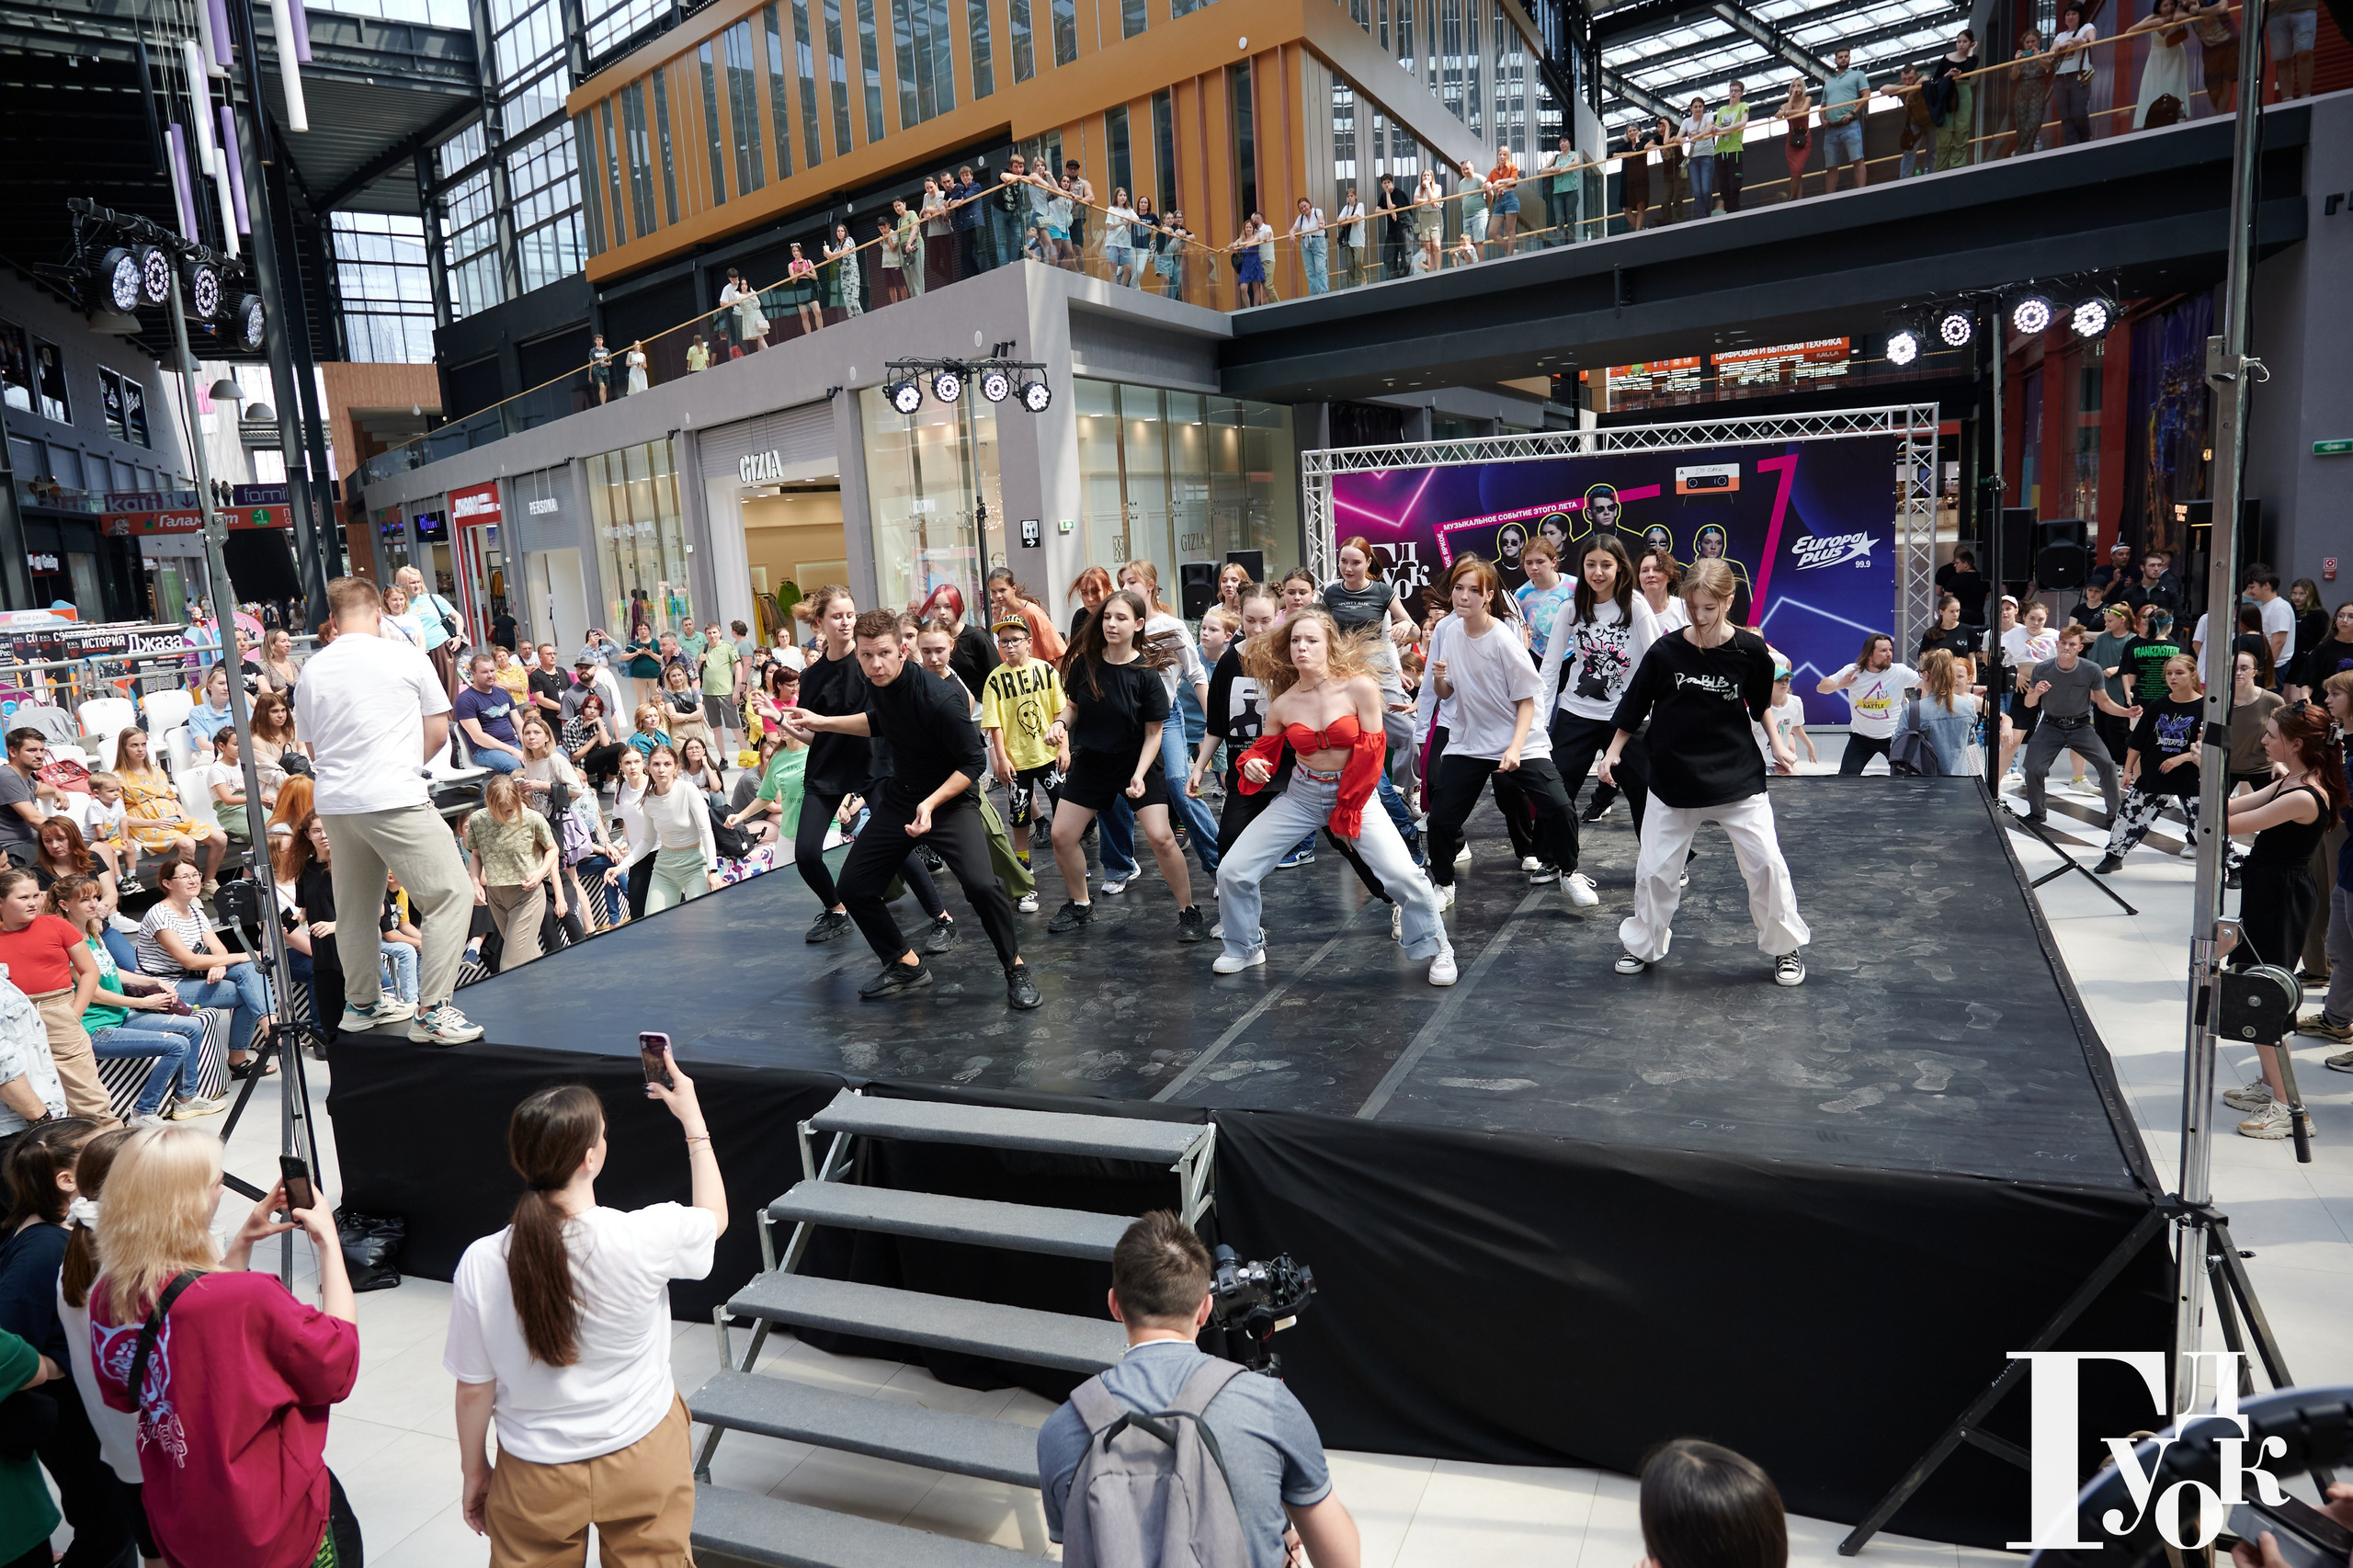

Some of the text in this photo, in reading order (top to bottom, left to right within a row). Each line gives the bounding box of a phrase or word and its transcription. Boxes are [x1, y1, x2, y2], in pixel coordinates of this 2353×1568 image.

[1715, 349, 1758, 361] ЦИФРОВАЯ
[1768, 342, 1804, 354] БЫТОВАЯ
[1805, 337, 1842, 349] ТЕХНИКА
[738, 449, 784, 483] GIZIA
[108, 494, 158, 512] kari
[529, 498, 559, 515] PERSONA
[1443, 501, 1577, 531] МУЗЫКАЛЬНОЕ СОБЫТИЕ ЭТОГО ЛЕТА
[1181, 533, 1206, 551] GIZIA
[1791, 532, 1863, 554] Europa
[1855, 561, 1871, 569] 99.9
[82, 635, 126, 649] ИСТОРИЯ
[128, 633, 183, 654] Джаза
